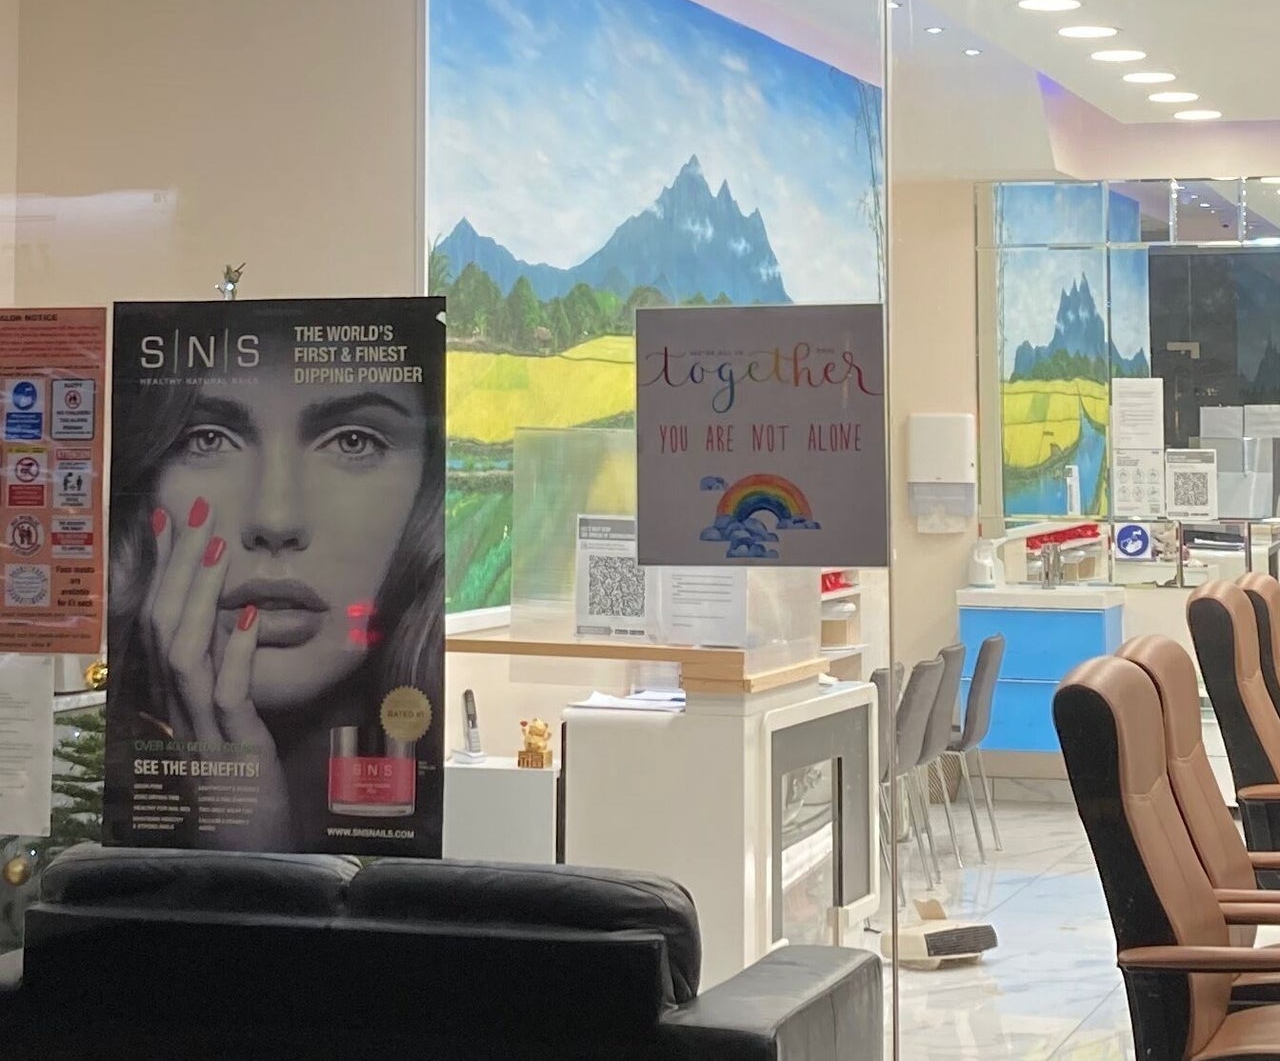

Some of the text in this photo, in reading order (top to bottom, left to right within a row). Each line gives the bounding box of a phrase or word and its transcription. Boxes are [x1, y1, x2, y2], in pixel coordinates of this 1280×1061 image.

[24, 314, 58, 322] NOTICE
[293, 325, 394, 342] THE WORLD'S
[293, 345, 408, 363] FIRST & FINEST
[293, 366, 423, 384] DIPPING POWDER
[638, 342, 884, 414] together
[658, 423, 862, 454] YOU ARE NOT ALONE
[134, 740, 164, 752] OVER
[133, 759, 260, 777] SEE THE BENEFITS!
